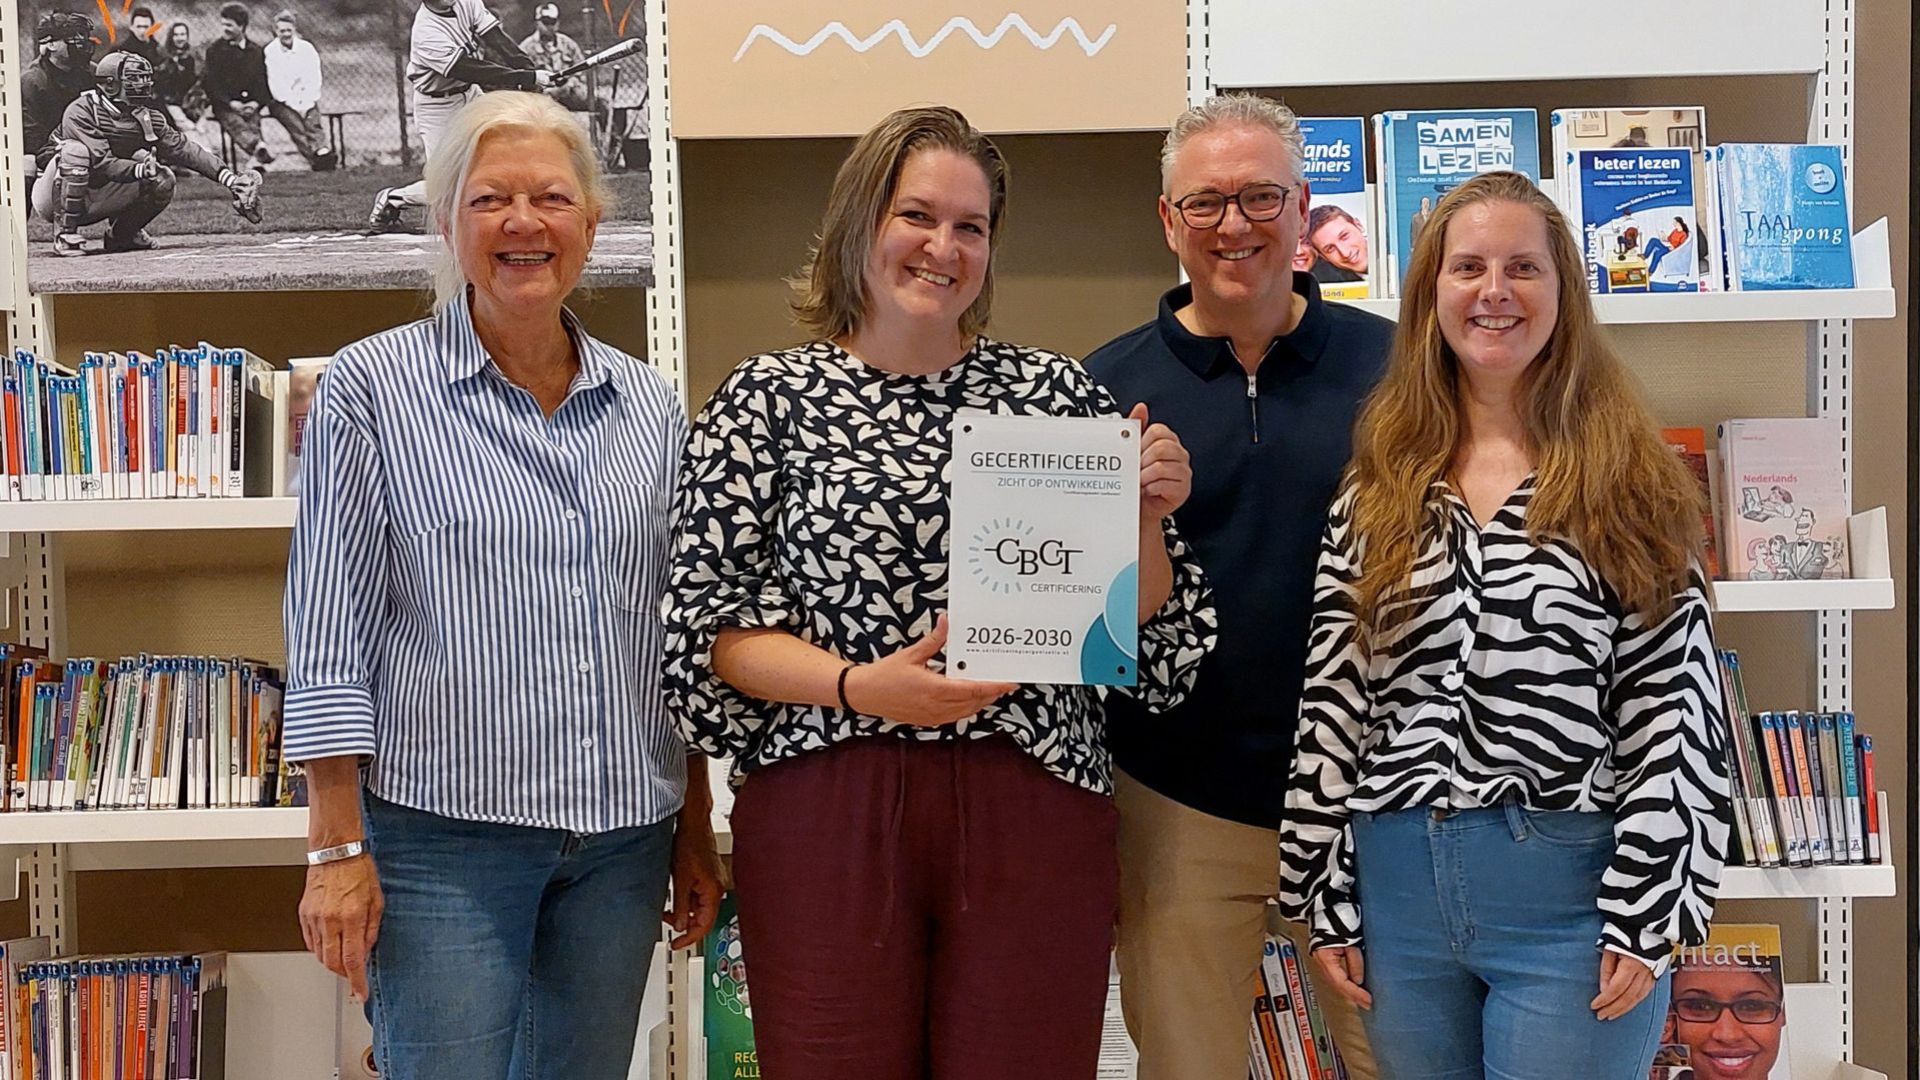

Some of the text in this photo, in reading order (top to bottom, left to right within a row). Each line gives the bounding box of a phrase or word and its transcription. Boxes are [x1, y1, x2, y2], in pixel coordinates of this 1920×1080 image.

[1419, 124, 1510, 144] SAMEN
[1422, 150, 1512, 171] LEZEN
[1594, 155, 1681, 170] beter lezen
[1585, 222, 1599, 294] tekstboek
[970, 451, 1122, 471] GECERTIFICEERD
[997, 477, 1122, 490] ZICHT OP ONTWIKKELING
[1743, 474, 1798, 484] Nederlands
[995, 538, 1083, 575] CBCT
[1030, 583, 1102, 594] CERTIFICERING
[966, 627, 1072, 647] 2026-2030
[1843, 727, 1854, 744] ATER
[1670, 941, 1771, 971] ntact!
[1288, 964, 1300, 986] TAAL
[1276, 996, 1287, 1010] 2
[138, 1009, 147, 1031] EFFECT
